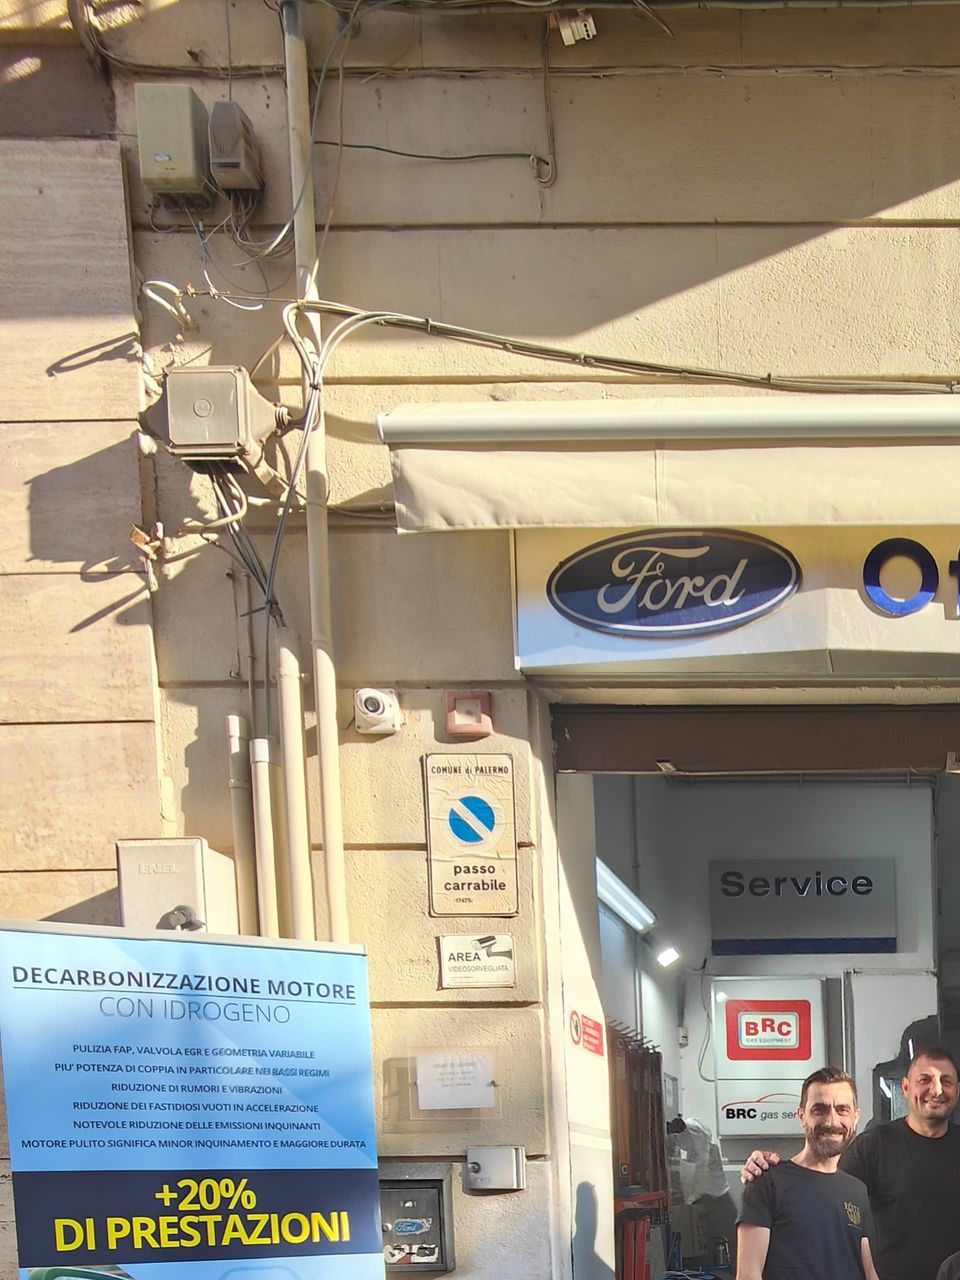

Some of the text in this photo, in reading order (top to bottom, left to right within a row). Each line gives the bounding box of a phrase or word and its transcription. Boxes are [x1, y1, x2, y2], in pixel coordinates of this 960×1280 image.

[597, 546, 748, 613] Ford
[431, 766, 509, 774] COMUNE di PALERMO
[453, 865, 496, 876] passo
[444, 879, 506, 891] carrabile
[720, 870, 873, 897] Service
[448, 952, 481, 962] AREA
[448, 964, 509, 973] VIDEOSORVEGLIATA
[12, 966, 356, 1000] DECARBONIZZAZIONE MOTORE
[99, 996, 291, 1024] CON IDROGENO
[745, 1017, 792, 1037] BRC
[72, 1044, 315, 1059] PULIZIA FAP, VALVOLA EGR E GEOMETRIA VARIABILE
[54, 1063, 330, 1078] PIU' POTENZA DI COPPIA IN PARTICOLARE NEI BASSI REGIMI
[111, 1083, 283, 1095] RIDUZIONE DI RUMORI E VIBRAZIONI
[73, 1101, 320, 1113] RIDUZIONE DEI FASTIDIOSI VUOTI IN ACCELERAZIONE
[725, 1108, 797, 1121] BRC gas ser
[73, 1120, 321, 1132] NOTEVOLE RIDUZIONE DELLE EMISSIONI INQUINANTI
[21, 1139, 367, 1149] MOTORE PULITO SIGNIFICA MINOR INQUINAMENTO E MAGGIORE DURATA
[154, 1178, 257, 1211] +20%
[54, 1210, 351, 1252] DI PRESTAZIONI
